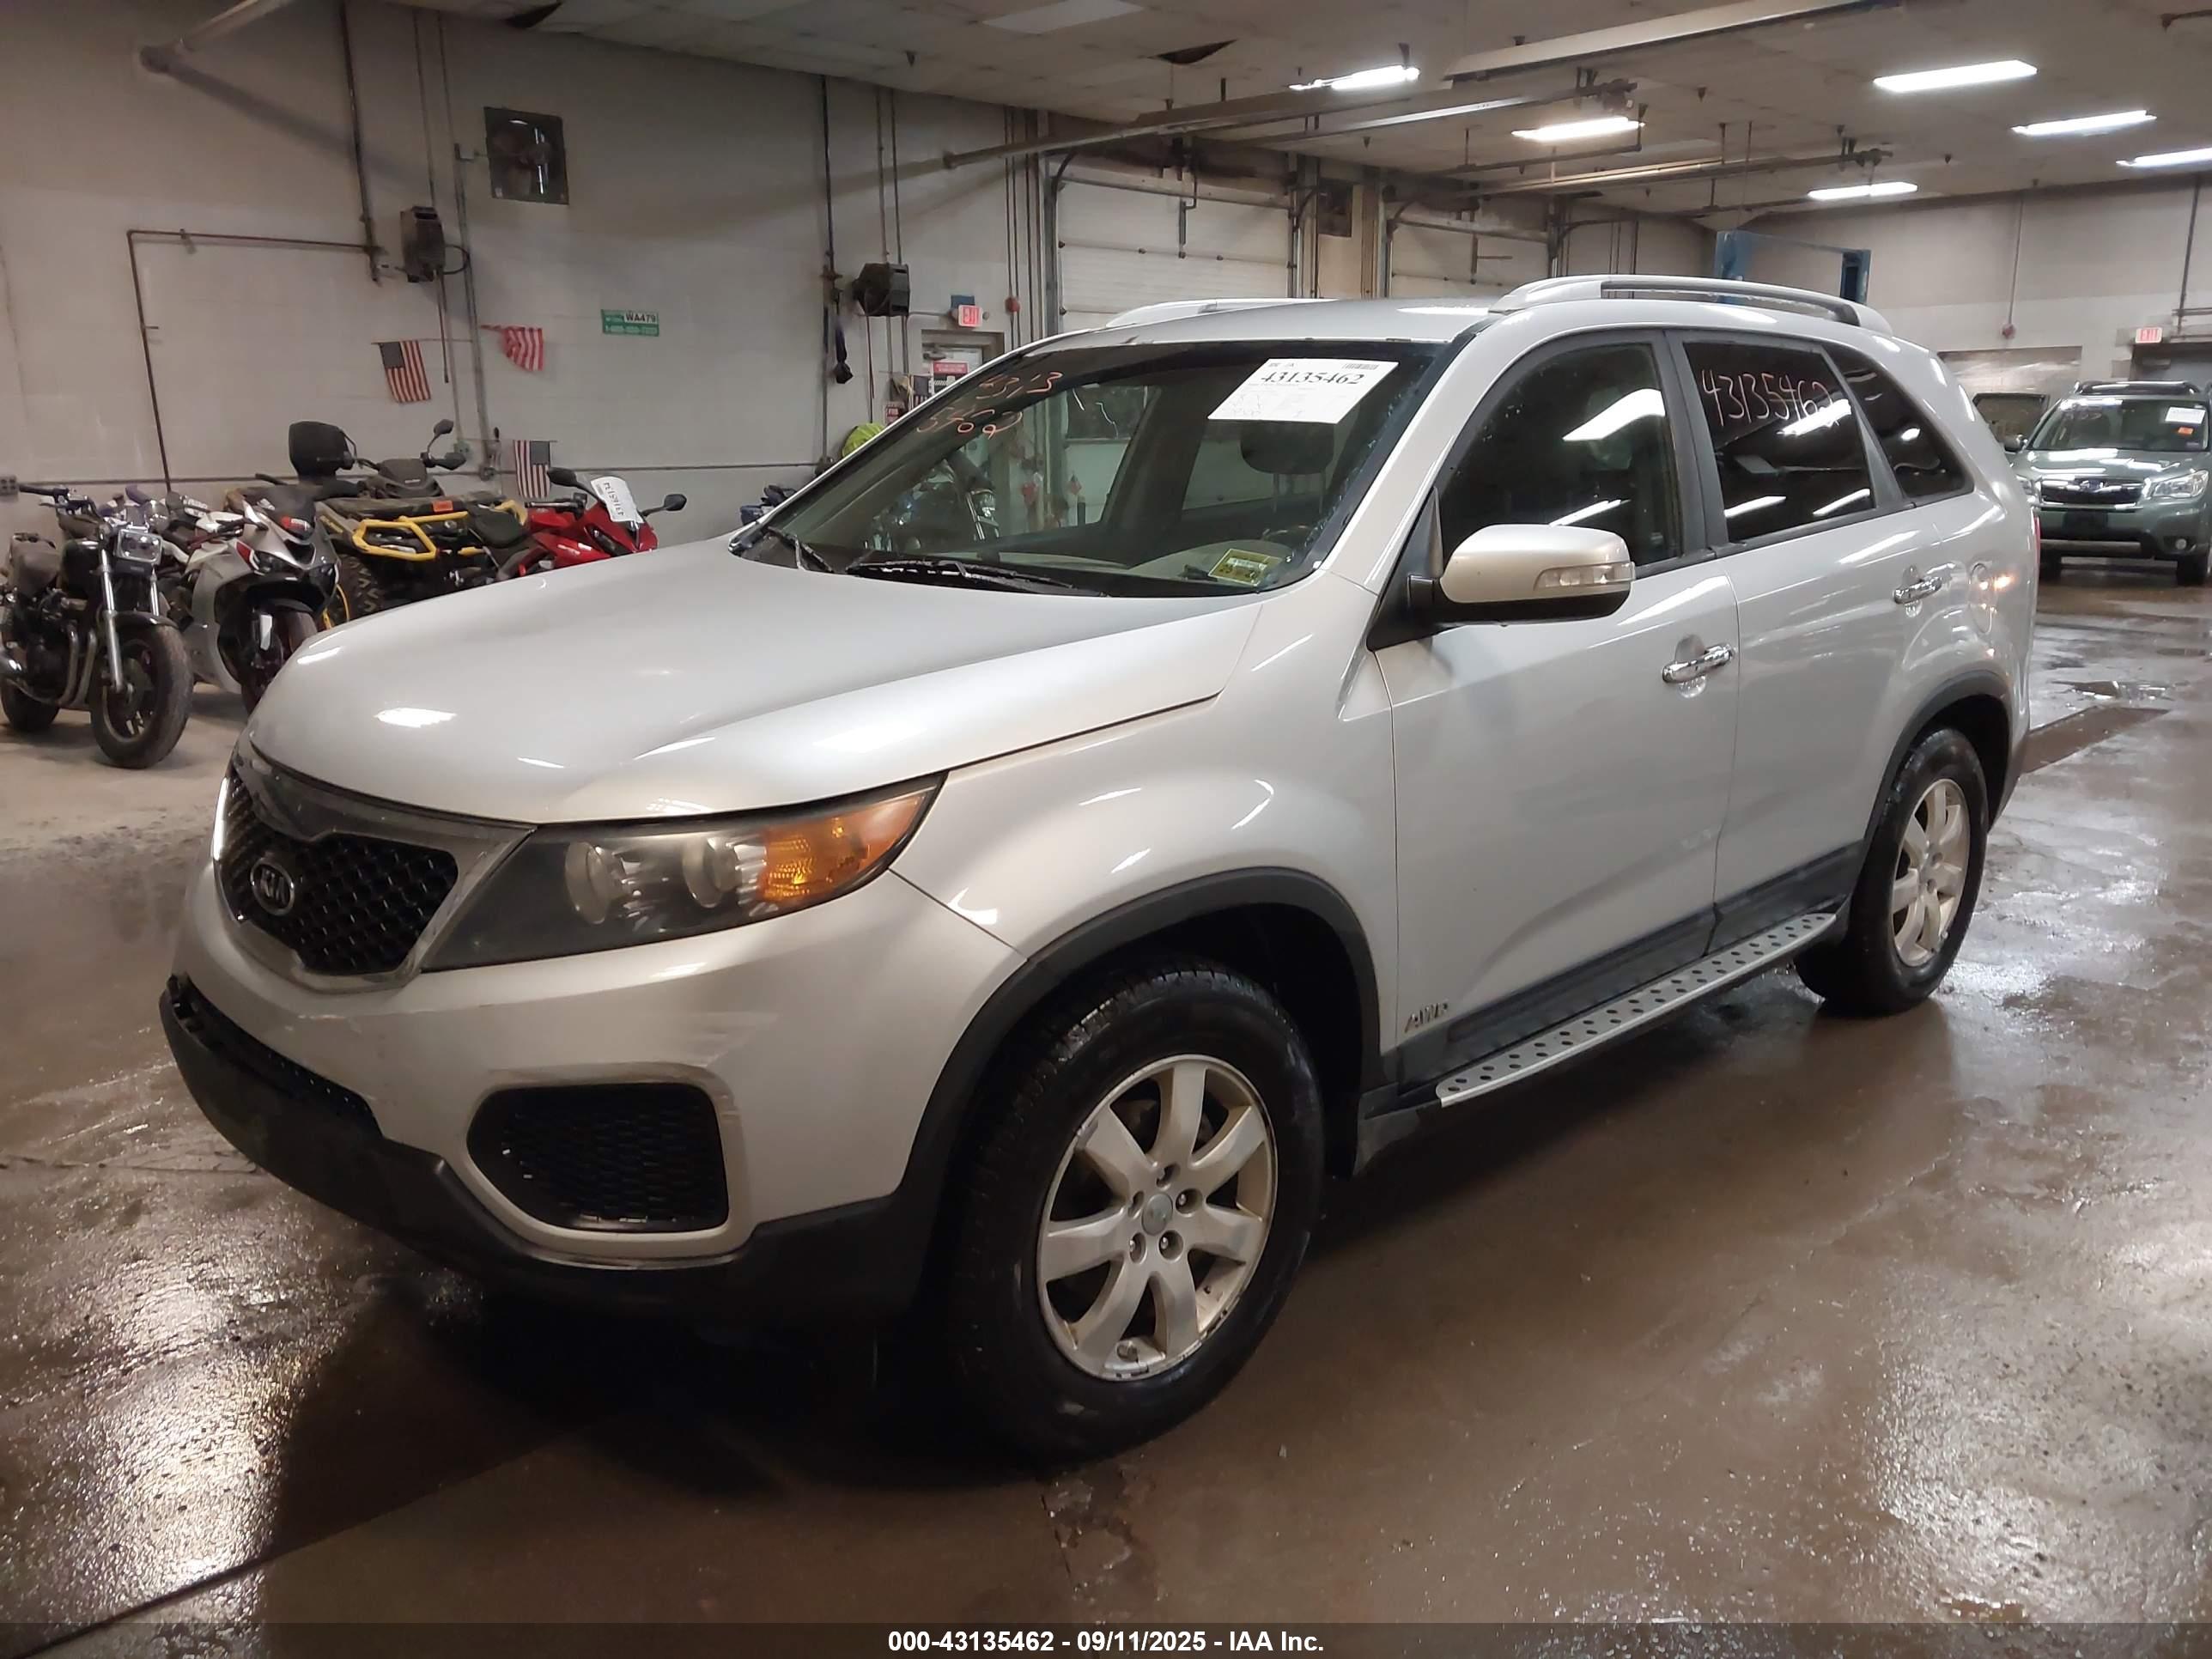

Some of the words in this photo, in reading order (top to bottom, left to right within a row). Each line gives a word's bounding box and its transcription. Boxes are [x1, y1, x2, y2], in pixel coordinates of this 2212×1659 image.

[626, 312, 656, 323] WA479
[1261, 371, 1365, 385] 43135462
[1701, 369, 1840, 427] 43135462
